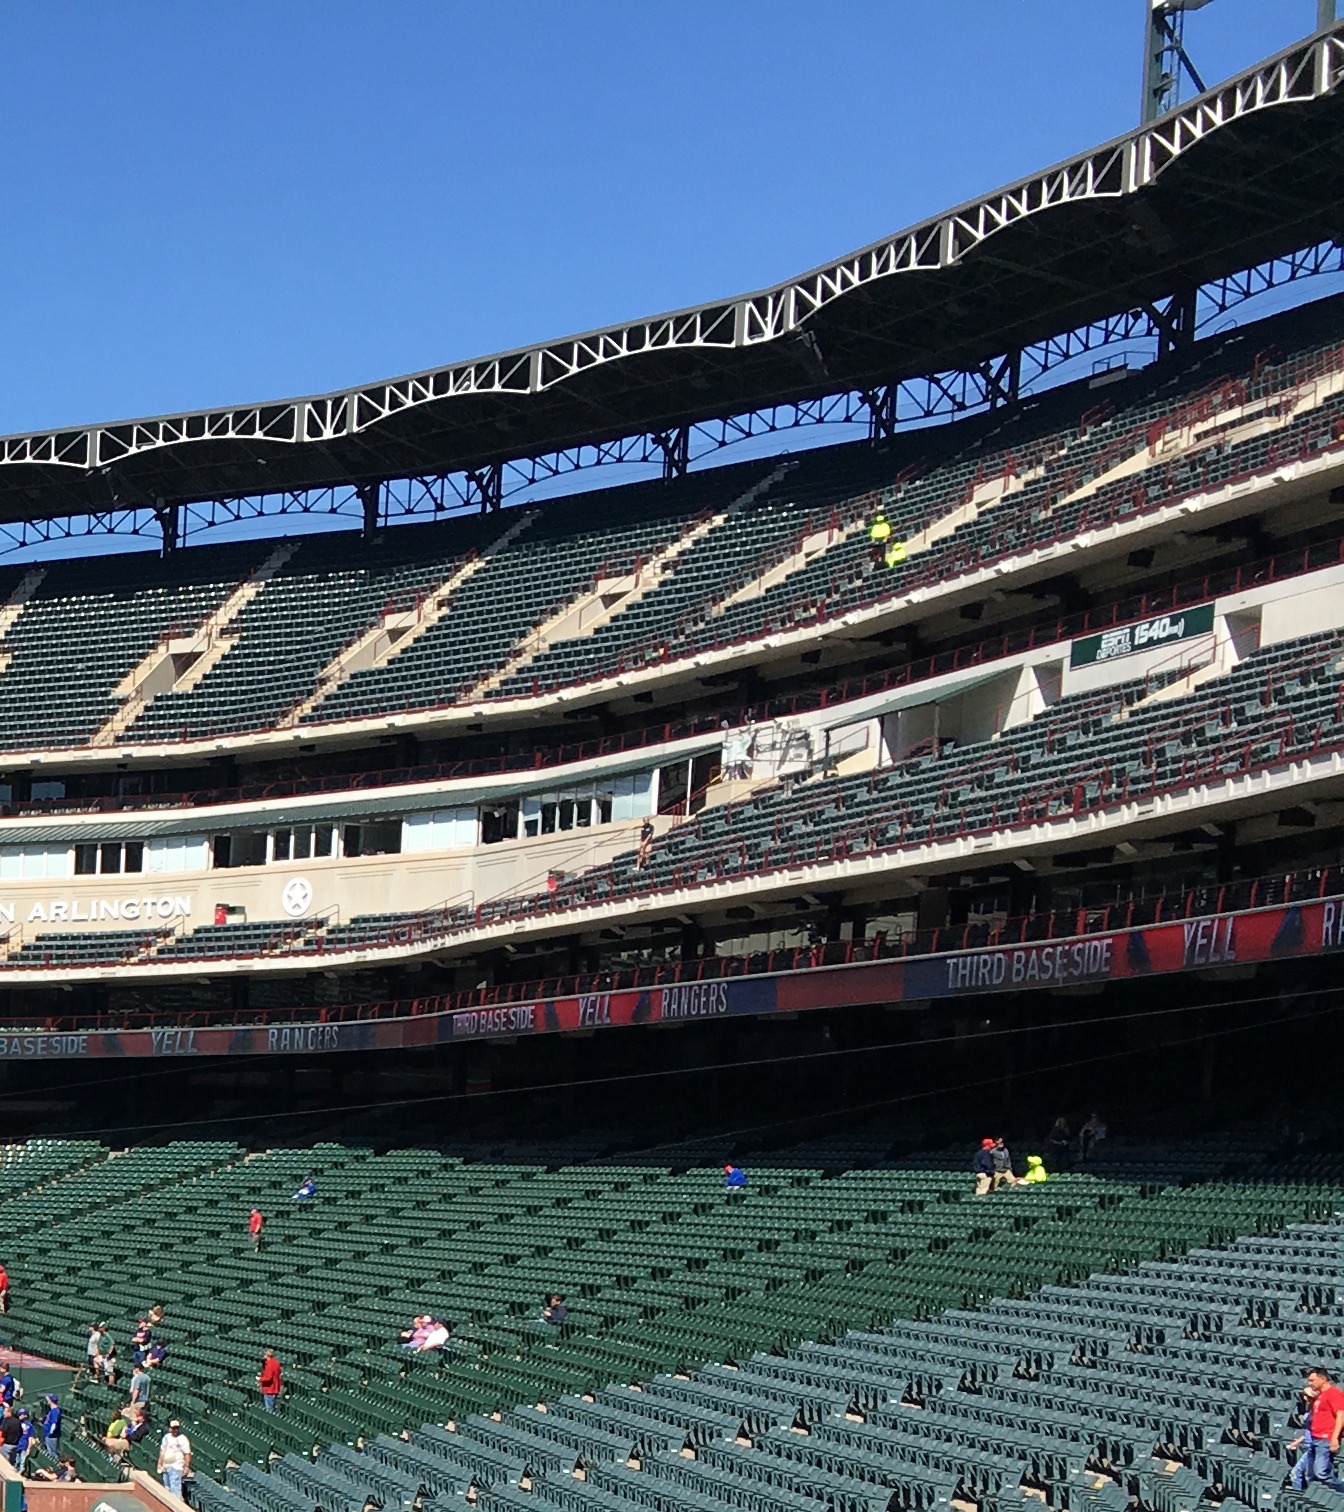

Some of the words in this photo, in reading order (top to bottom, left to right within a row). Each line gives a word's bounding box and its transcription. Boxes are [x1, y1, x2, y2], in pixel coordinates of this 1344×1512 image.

[1100, 628, 1131, 649] ESPN
[1134, 617, 1171, 645] 1540
[27, 896, 193, 922] ARLINGTON
[1183, 916, 1236, 966] YELL
[946, 953, 1006, 989] THIRD
[1013, 944, 1067, 983] BASE
[1071, 937, 1112, 976] SIDE
[577, 994, 611, 1026] YELL
[661, 983, 729, 1018] RANGERS
[452, 1014, 478, 1035] THIRD
[480, 1009, 508, 1033] BASE
[510, 1005, 535, 1030] SIDE
[52, 1035, 88, 1054] SIDE
[151, 1030, 198, 1054] YELL
[268, 1025, 339, 1051] RANGERS
